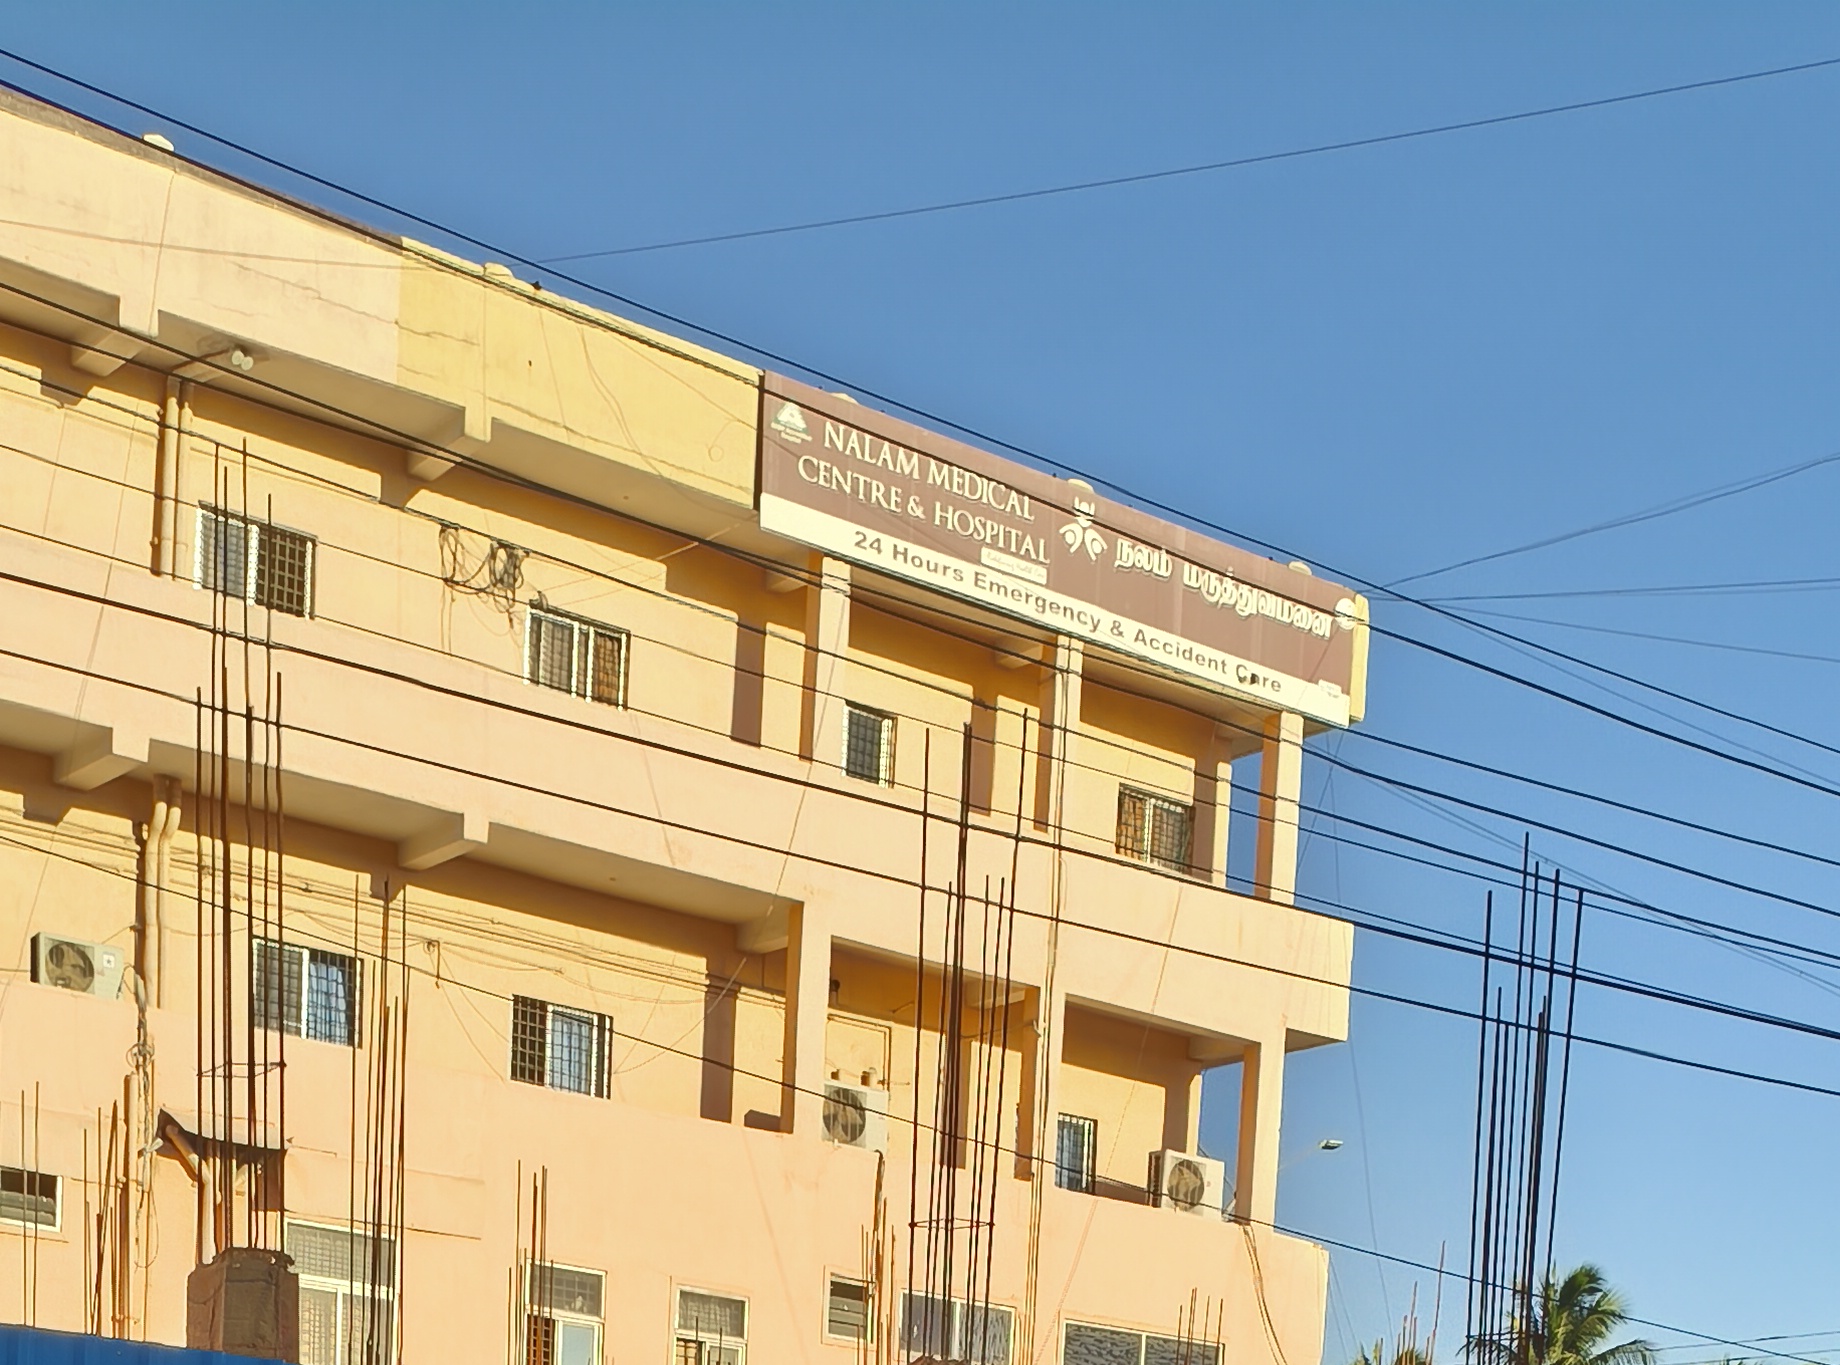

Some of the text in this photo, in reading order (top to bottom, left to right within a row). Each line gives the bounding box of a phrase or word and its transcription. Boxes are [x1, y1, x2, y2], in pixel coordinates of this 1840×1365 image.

[797, 454, 1050, 564] CENTRE & HOSPITAL
[823, 421, 1035, 522] NALAM MEDICAL
[854, 530, 883, 555] 24
[892, 543, 964, 583] Hours
[974, 571, 1101, 633] Emergency
[1110, 620, 1125, 639] &
[1133, 628, 1228, 675] Accident
